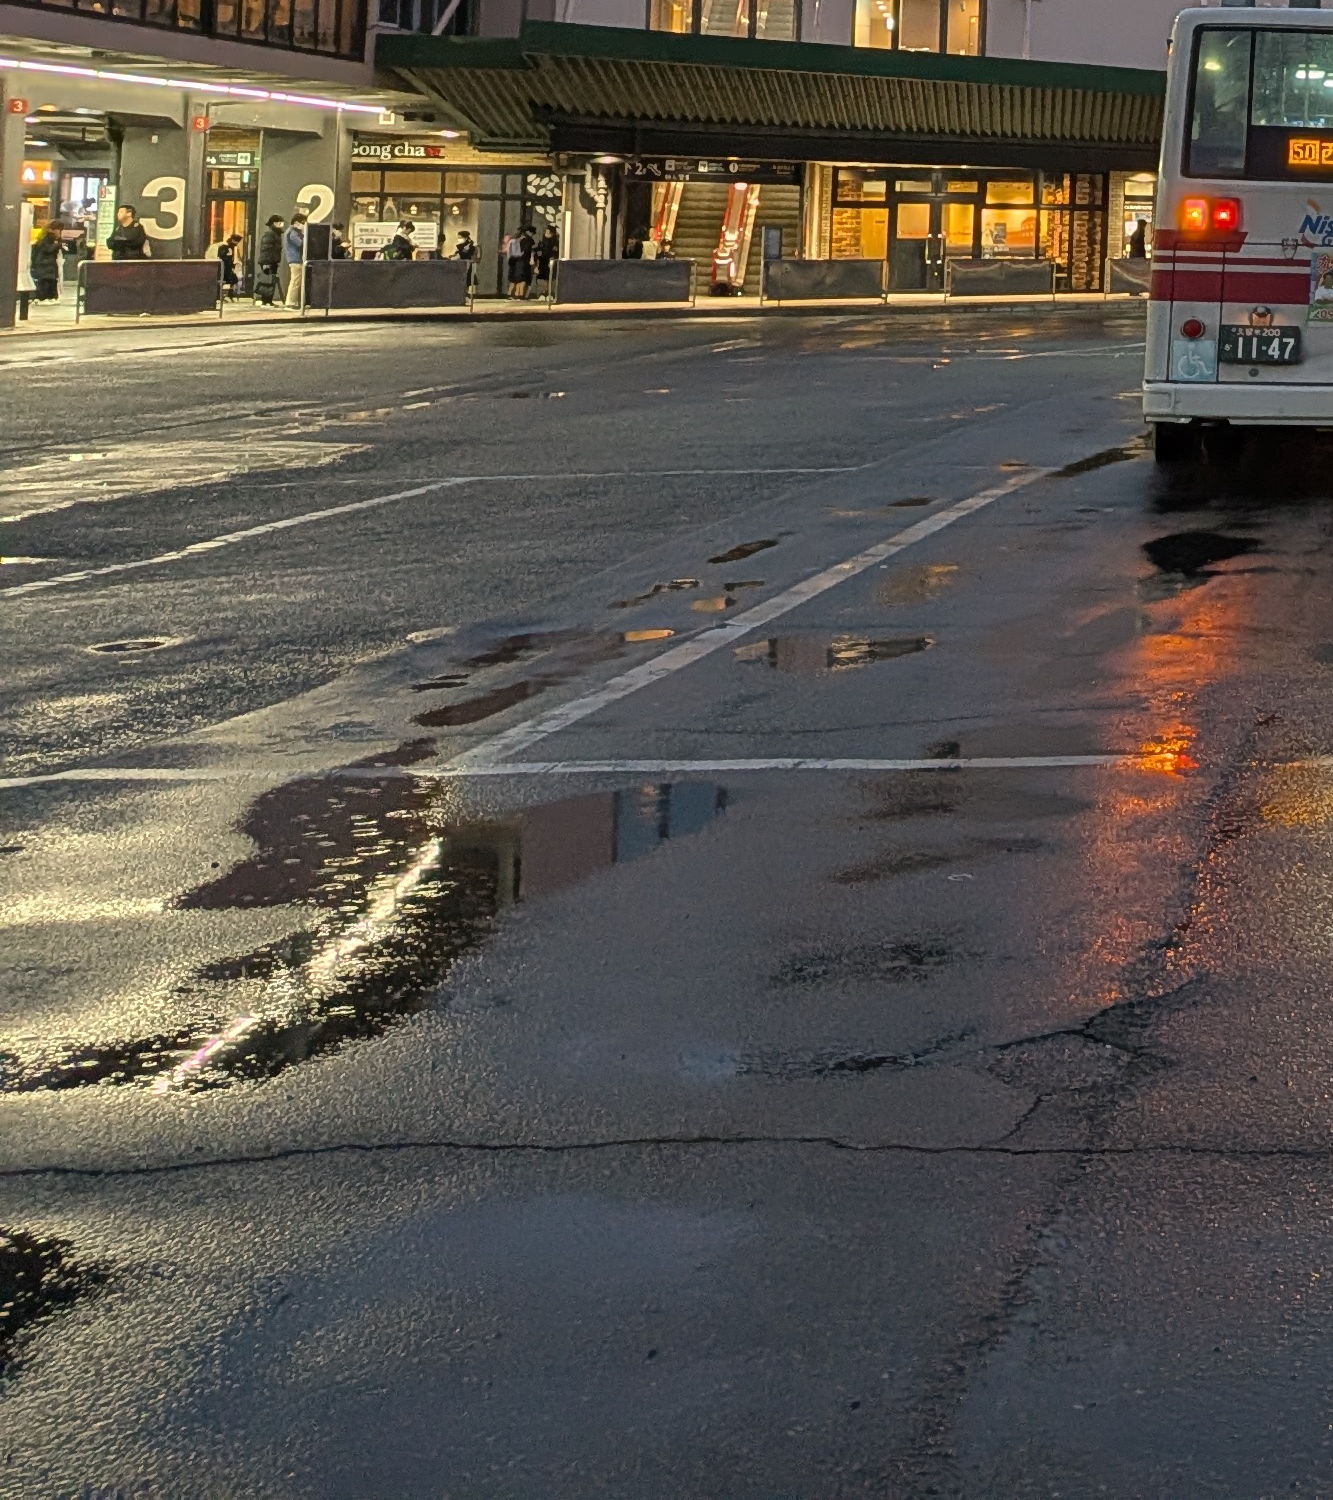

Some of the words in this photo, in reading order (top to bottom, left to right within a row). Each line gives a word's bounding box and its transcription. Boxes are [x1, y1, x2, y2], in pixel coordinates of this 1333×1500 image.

[14, 100, 23, 112] 3
[196, 119, 204, 129] 3
[394, 142, 426, 157] cha
[139, 176, 185, 240] 3
[297, 184, 335, 224] 2
[1237, 337, 1295, 359] 11-47
